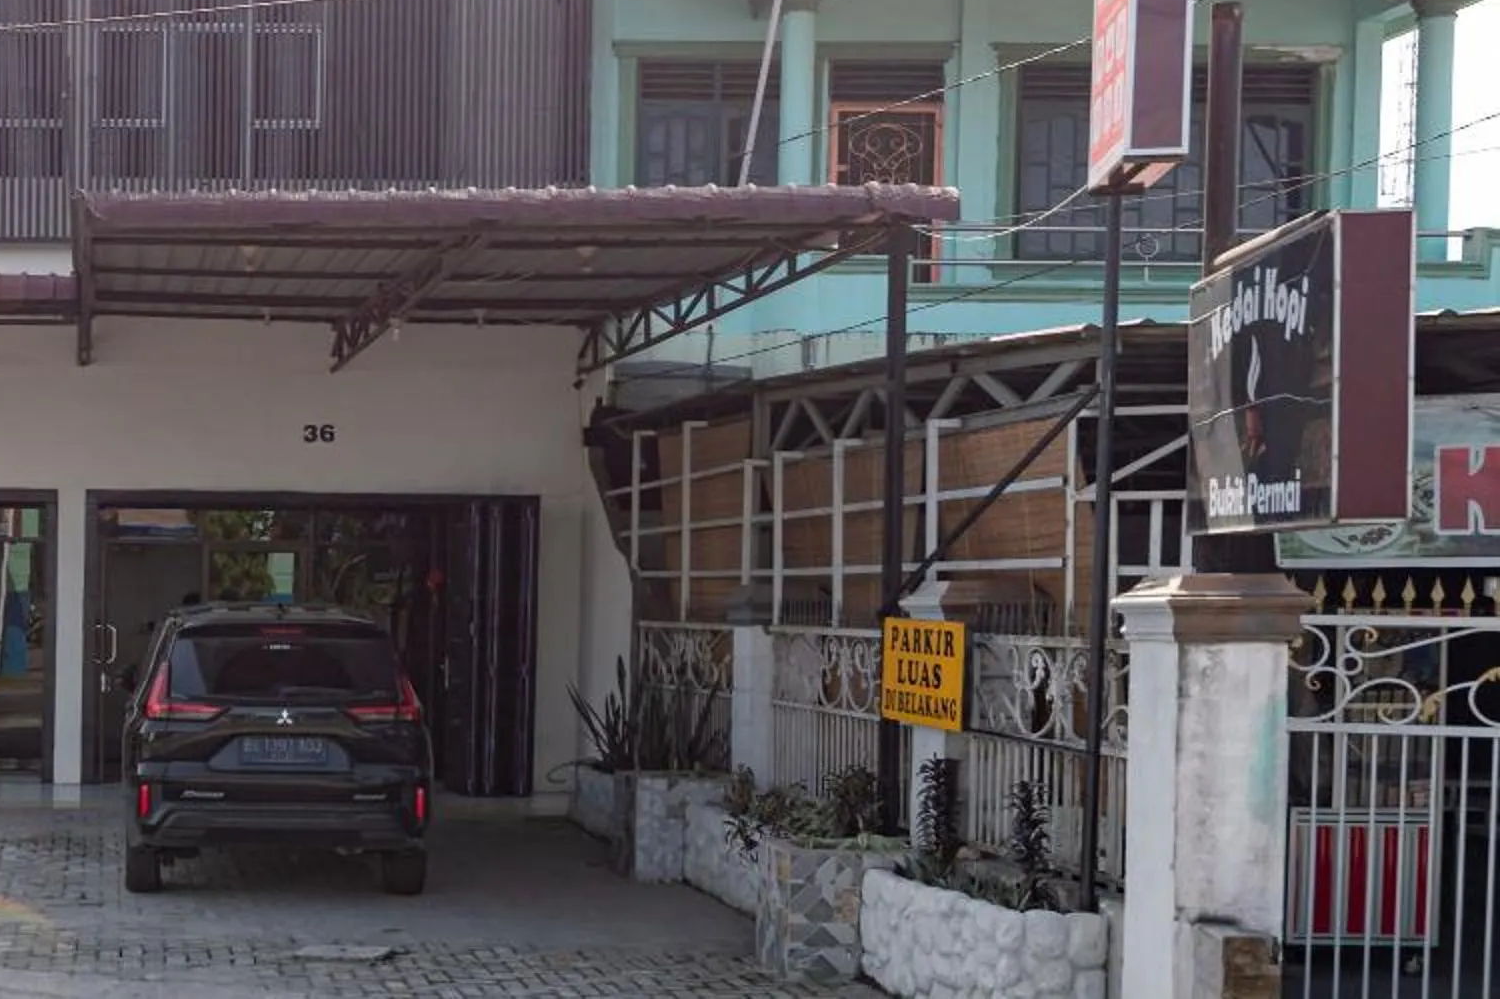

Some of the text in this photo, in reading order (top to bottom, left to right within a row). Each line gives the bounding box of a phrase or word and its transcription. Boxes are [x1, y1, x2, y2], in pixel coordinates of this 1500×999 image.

[1211, 265, 1309, 360] Kedai Kopi
[303, 424, 336, 443] 36
[1209, 468, 1301, 517] Bukit Permai
[890, 625, 955, 658] PARKIR
[897, 658, 942, 689] LUAS
